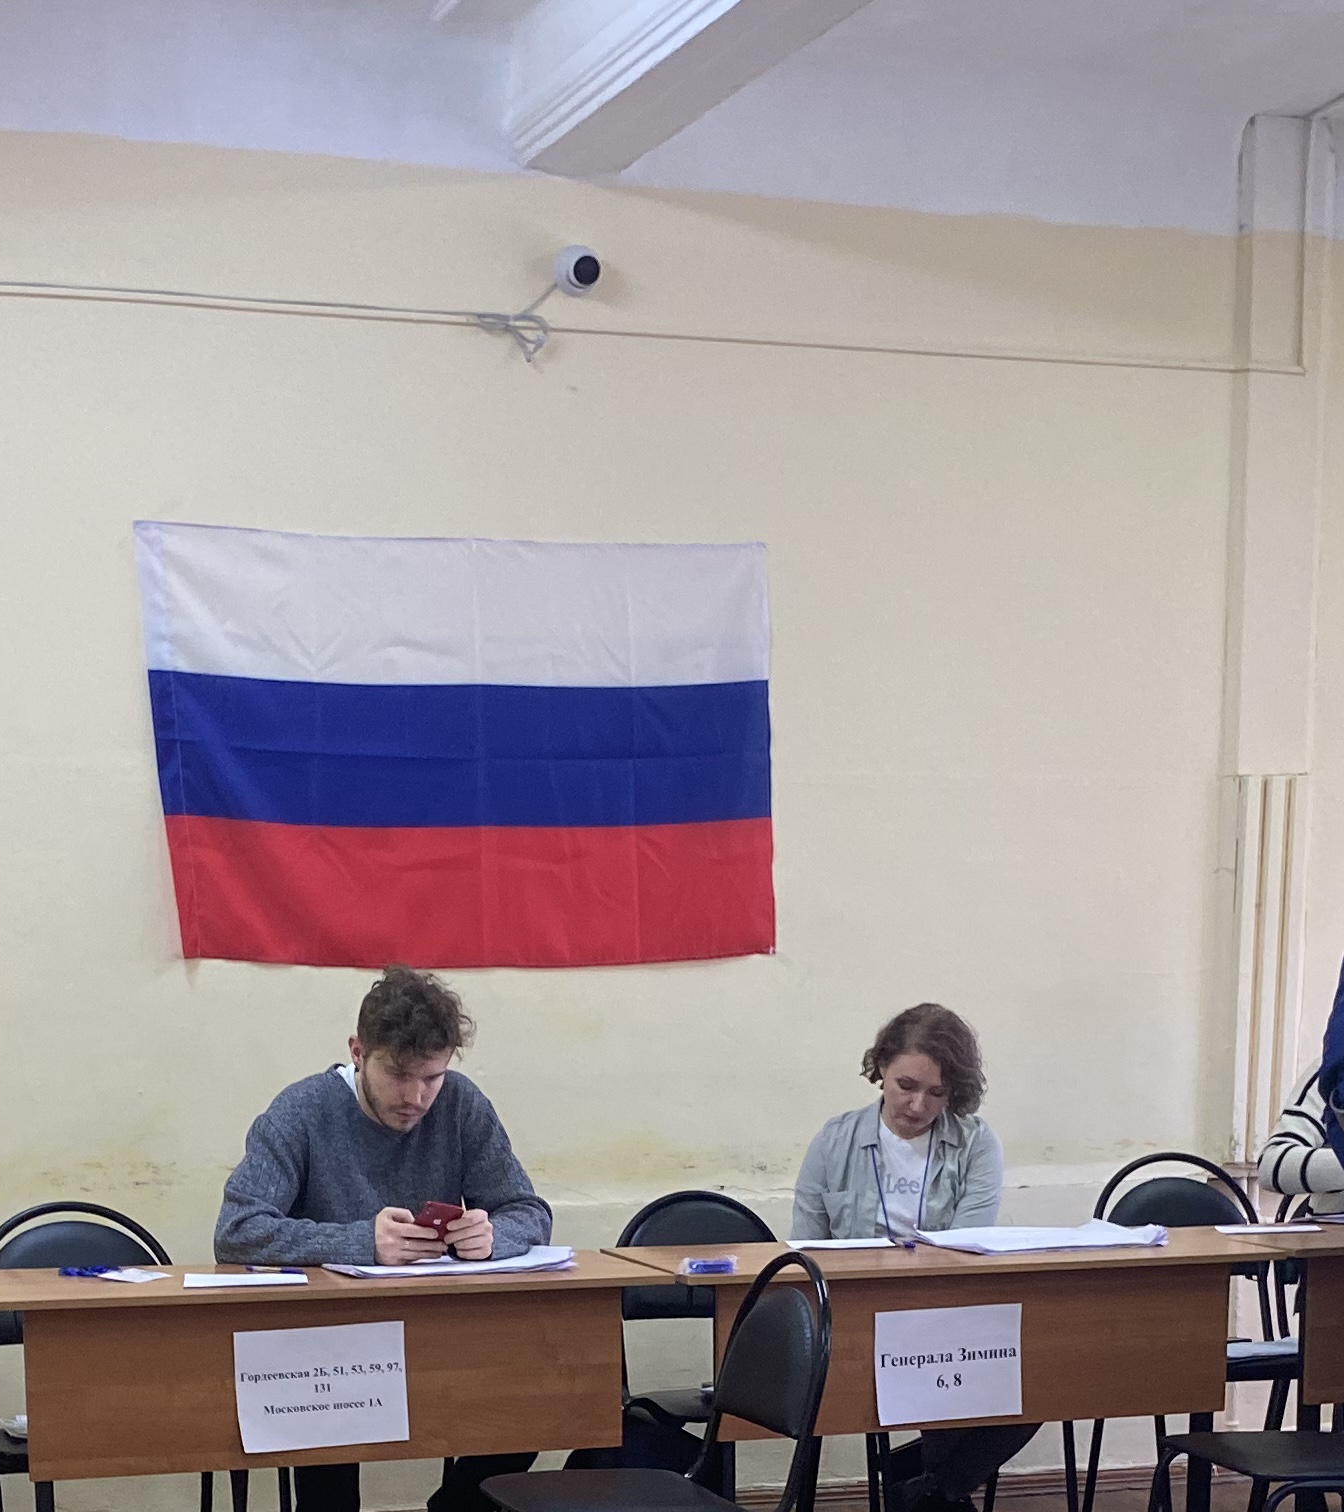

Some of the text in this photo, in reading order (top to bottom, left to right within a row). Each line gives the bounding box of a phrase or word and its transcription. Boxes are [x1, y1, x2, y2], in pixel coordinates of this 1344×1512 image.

[885, 1173, 920, 1194] Lee
[880, 1347, 1017, 1368] Генерала Зимина
[240, 1370, 310, 1384] Гордеевская
[936, 1373, 962, 1389] 6, 8
[314, 1383, 331, 1393] 131
[263, 1403, 330, 1415] Московское
[333, 1400, 365, 1410] шоссе
